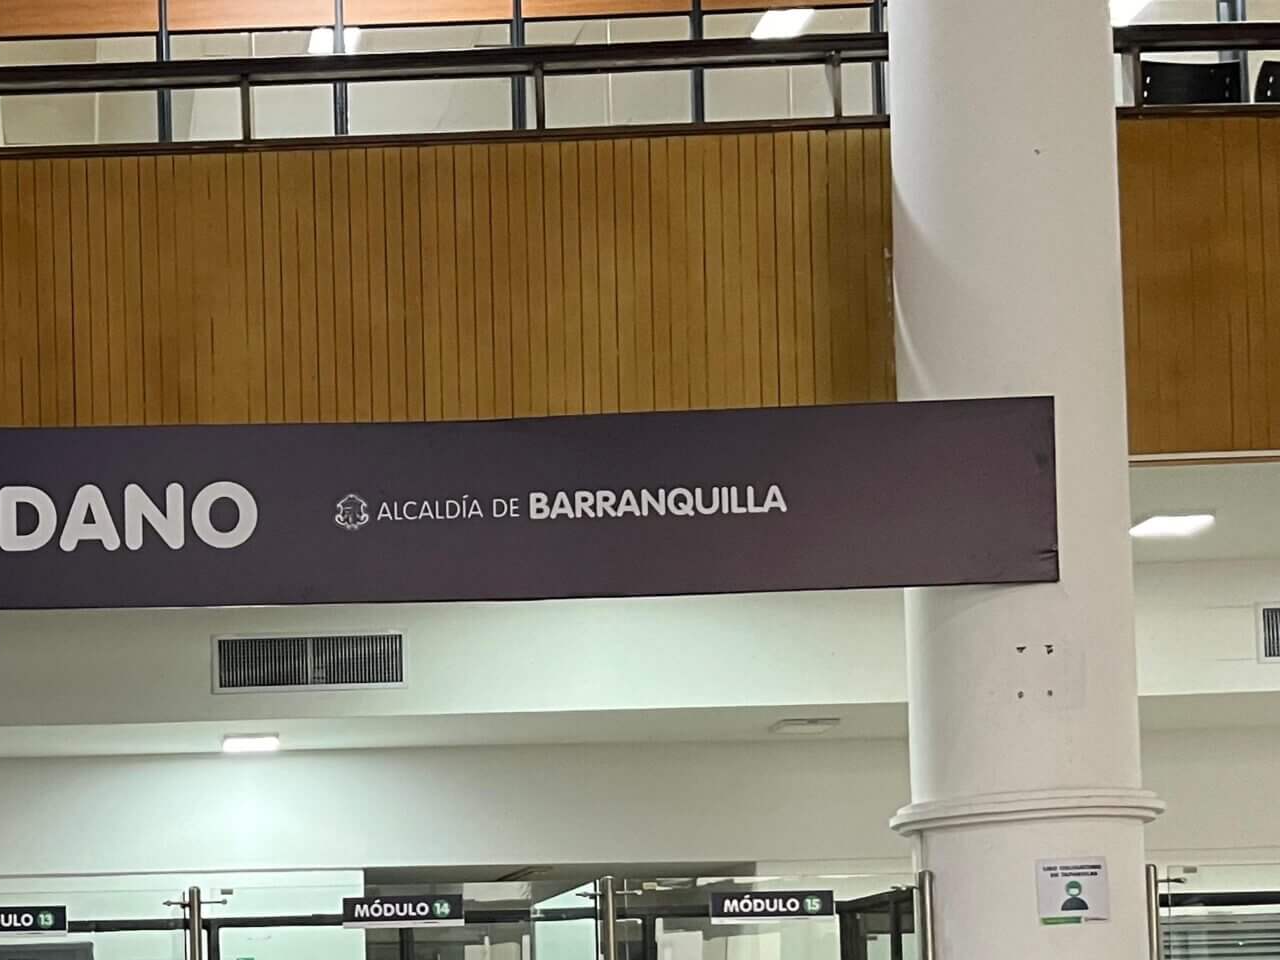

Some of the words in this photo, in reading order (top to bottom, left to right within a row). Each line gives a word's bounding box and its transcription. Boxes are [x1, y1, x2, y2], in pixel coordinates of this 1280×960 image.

[376, 494, 484, 521] ALCALDÍA
[492, 497, 521, 518] DE
[529, 484, 788, 520] BARRANQUILLA
[354, 899, 430, 918] MÓDULO
[433, 902, 451, 916] 14
[723, 894, 800, 913] MÓDULO
[804, 898, 821, 912] 15
[38, 913, 54, 927] 13
